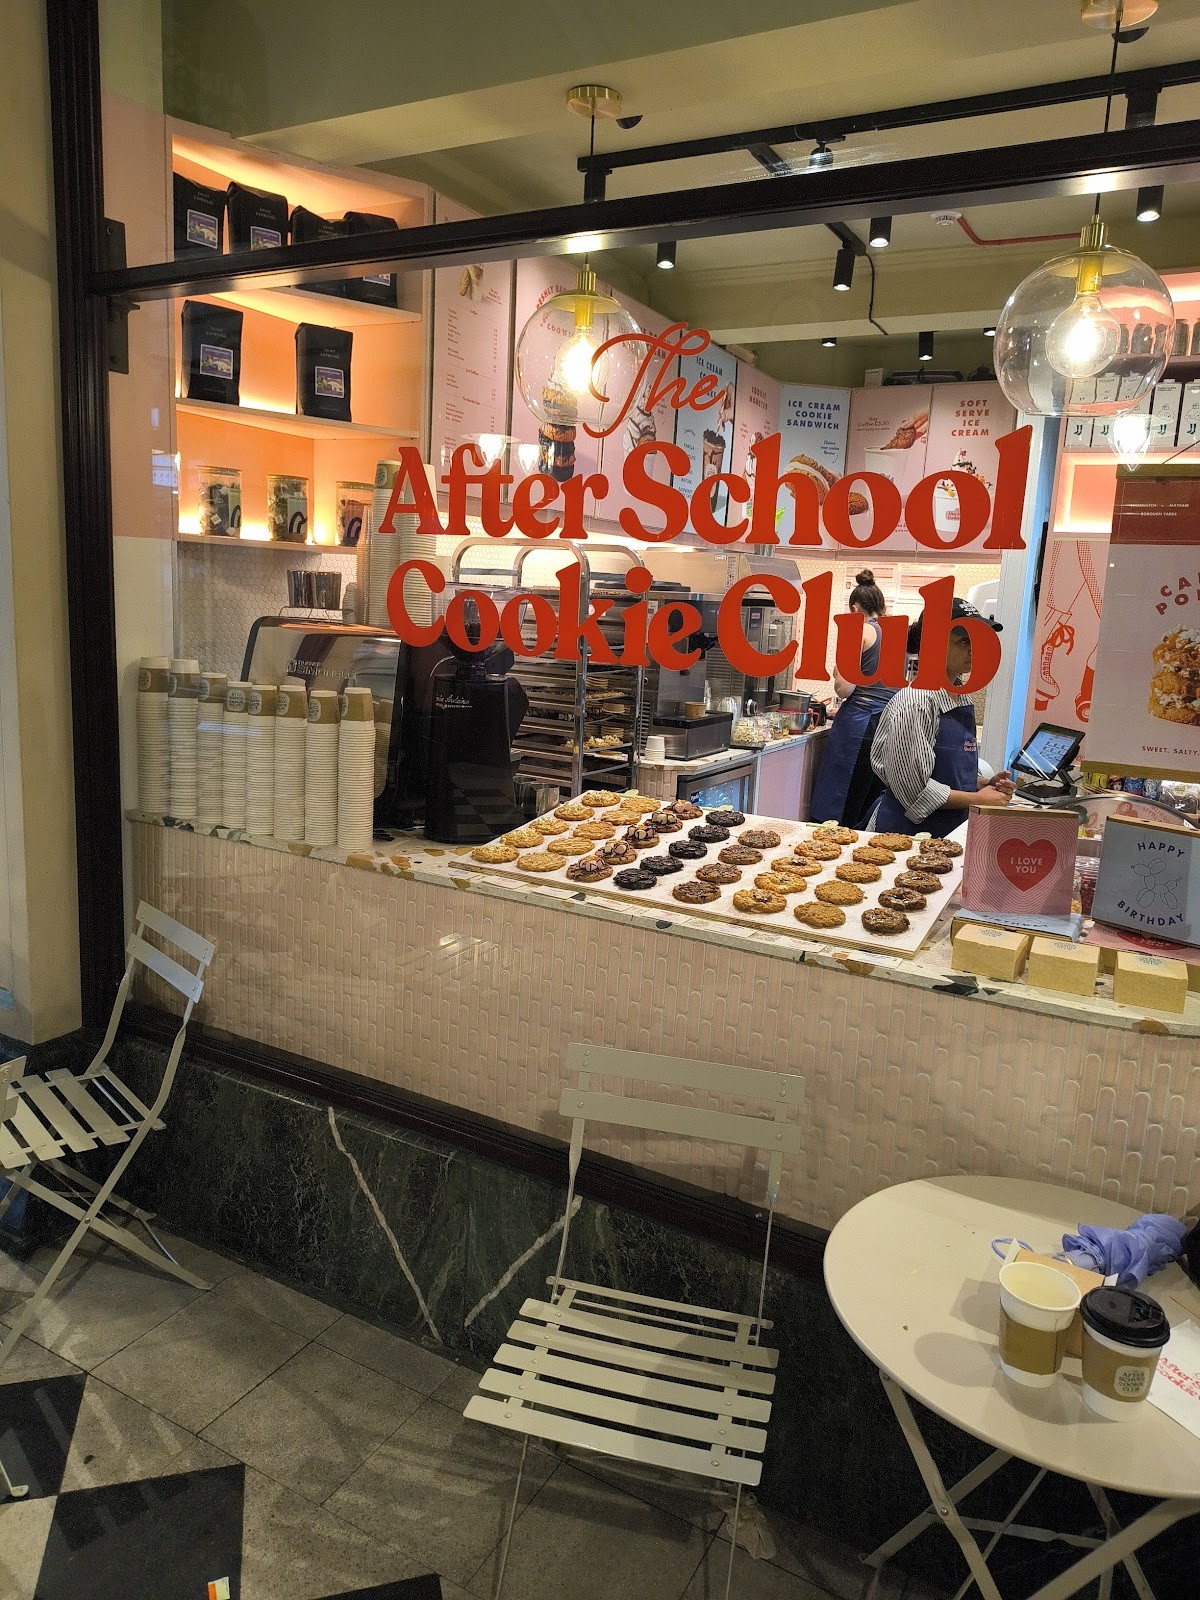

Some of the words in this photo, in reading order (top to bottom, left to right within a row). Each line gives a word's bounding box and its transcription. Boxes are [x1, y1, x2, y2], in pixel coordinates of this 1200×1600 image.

[707, 362, 723, 376] CREAM
[583, 322, 725, 438] The
[752, 386, 767, 398] COOKIE
[749, 396, 768, 410] MONSTER
[788, 400, 803, 408] ICE
[808, 402, 840, 411] CREAM
[796, 410, 832, 419] COOKIE
[787, 419, 839, 430] SANDWICH
[380, 446, 609, 539] After
[619, 424, 1033, 549] School
[1160, 572, 1200, 597] CA
[1155, 590, 1200, 615] PO
[386, 560, 702, 670] Cookie
[718, 571, 1002, 694] Club
[1137, 841, 1185, 858] HAPPY
[1018, 857, 1043, 865] LOVE
[1117, 900, 1185, 926] BIRTHDAY
